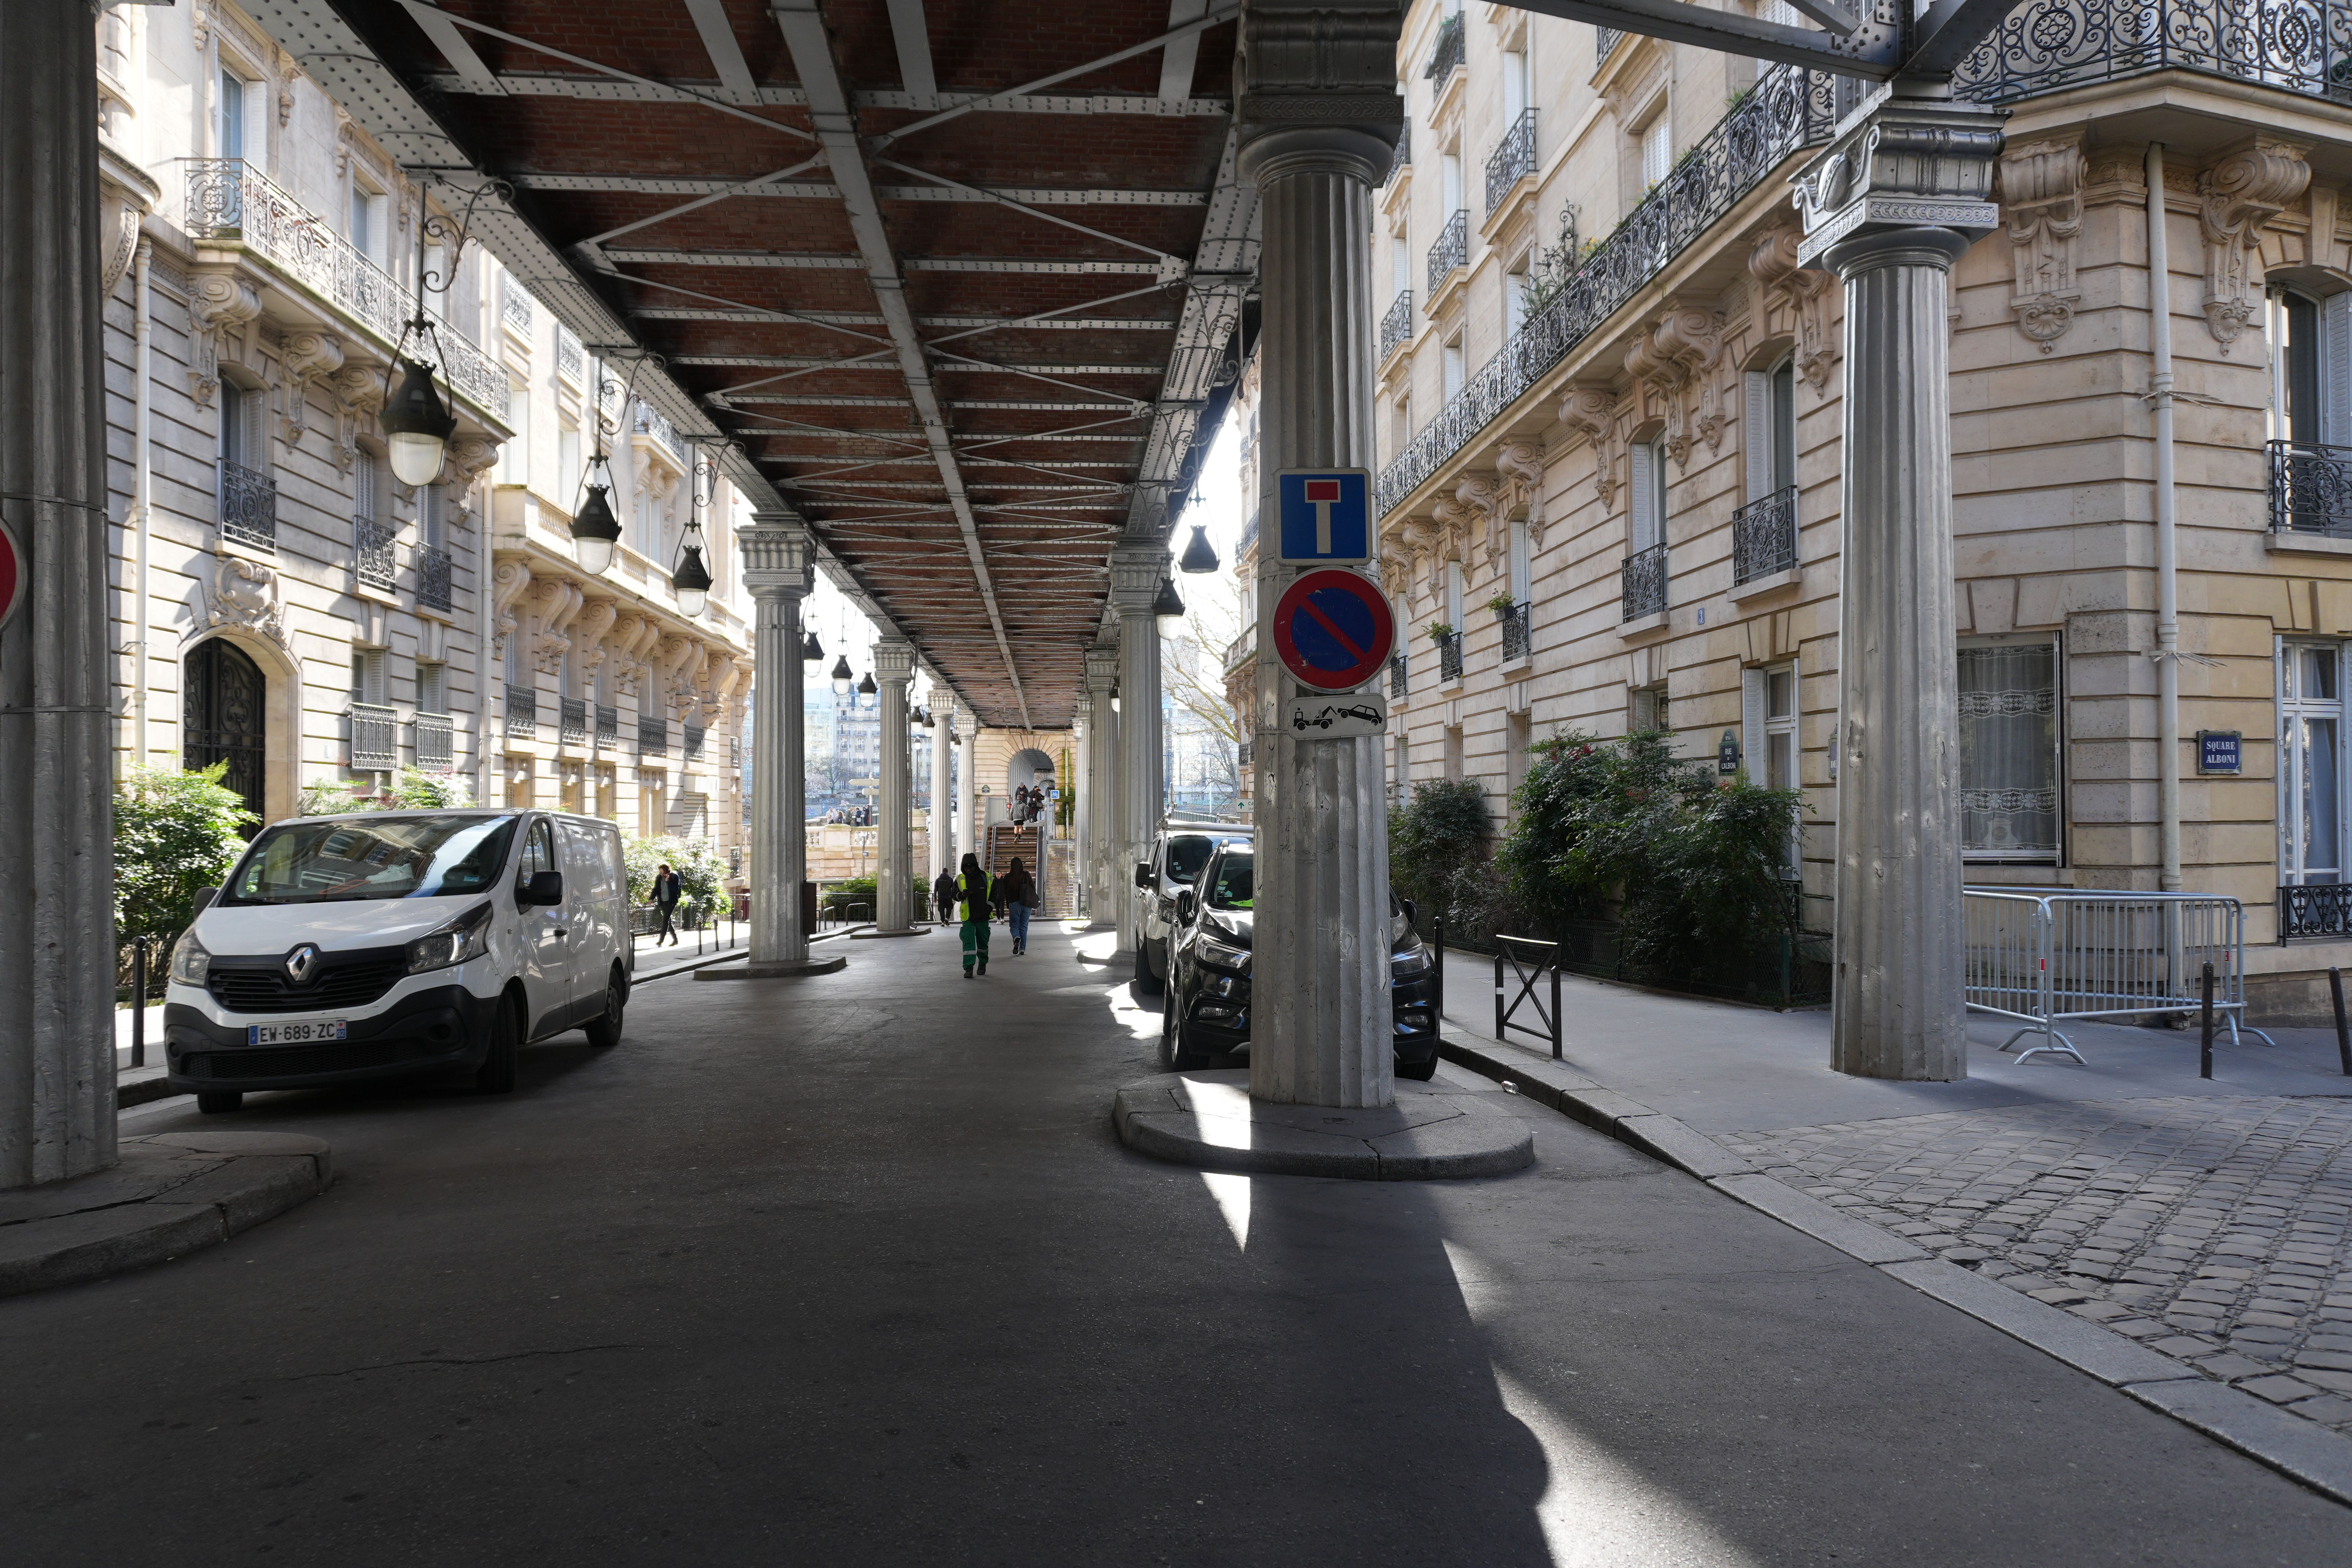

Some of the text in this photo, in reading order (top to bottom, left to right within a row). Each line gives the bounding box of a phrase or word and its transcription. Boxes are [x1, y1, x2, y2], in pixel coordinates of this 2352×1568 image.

[1699, 610, 1703, 623] 3
[2206, 741, 2235, 751] SQUARE
[2206, 755, 2235, 763] ALBONI
[260, 1023, 335, 1042] EW-689-ZC
